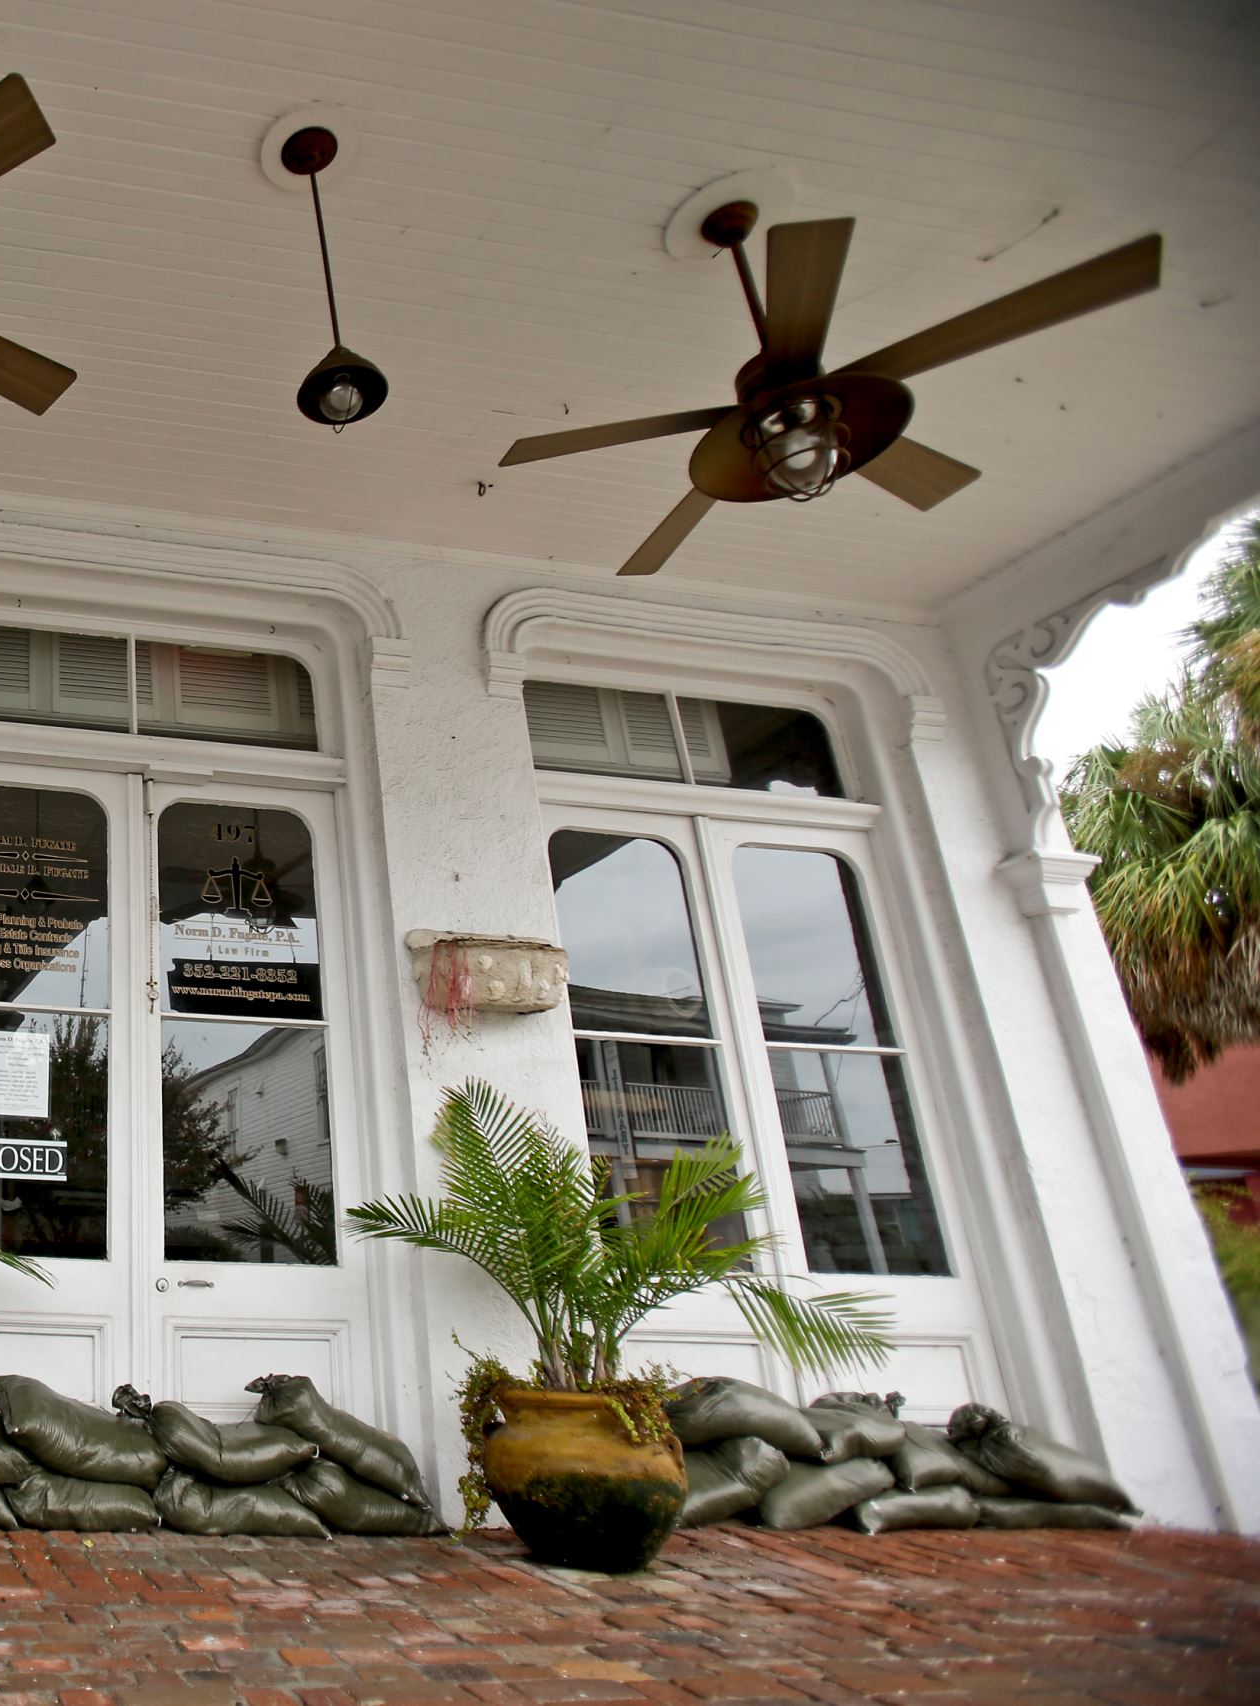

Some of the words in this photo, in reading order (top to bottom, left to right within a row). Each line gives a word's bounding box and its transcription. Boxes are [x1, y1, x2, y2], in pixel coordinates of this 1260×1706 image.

[38, 915, 46, 928] &
[47, 917, 84, 931] Probate
[29, 929, 74, 944] Contracts
[174, 924, 209, 938] Norm
[211, 926, 226, 939] D.
[275, 930, 300, 943] P.A.
[3, 942, 12, 954] &
[12, 942, 34, 955] Title
[35, 944, 80, 959] Insurance
[218, 945, 238, 956] Law
[244, 946, 270, 958] Firm
[13, 957, 77, 973] Organizations
[183, 963, 297, 984] 352-221-8352
